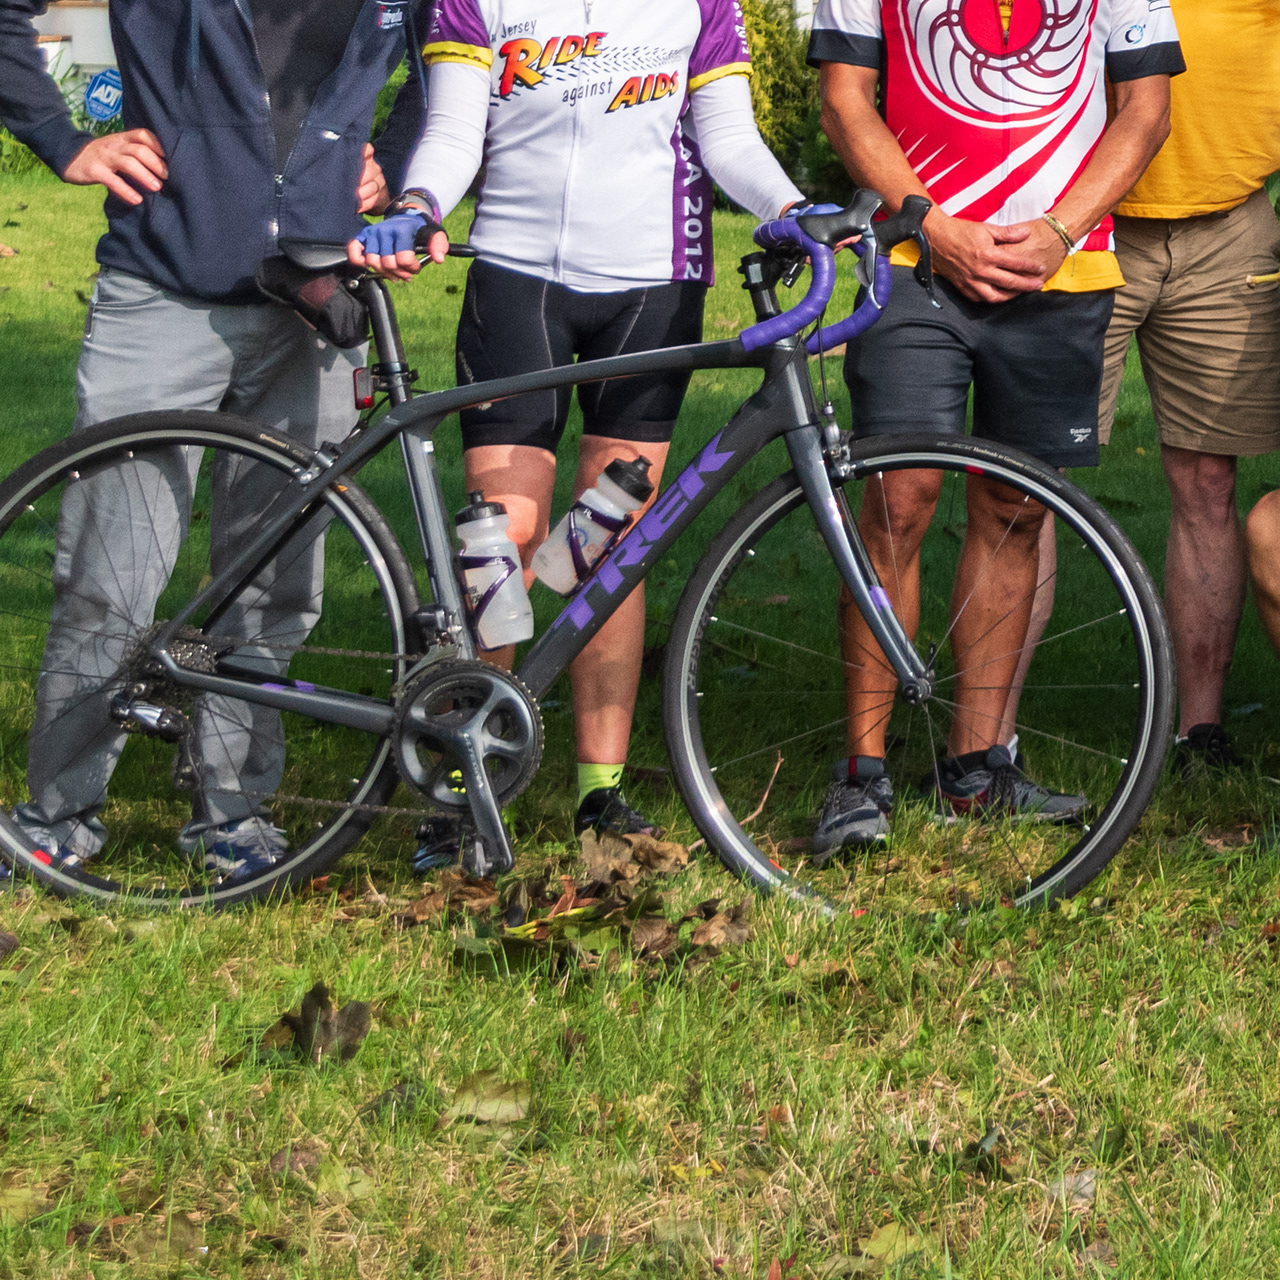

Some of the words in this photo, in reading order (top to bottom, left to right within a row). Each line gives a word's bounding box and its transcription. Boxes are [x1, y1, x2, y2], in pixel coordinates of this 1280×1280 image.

[501, 20, 537, 40] Jersey
[499, 31, 608, 97] RIDE
[90, 83, 122, 108] ADT
[562, 75, 613, 108] against
[604, 70, 679, 114] AIDS
[683, 195, 704, 280] 2012
[553, 431, 737, 631] TREK
